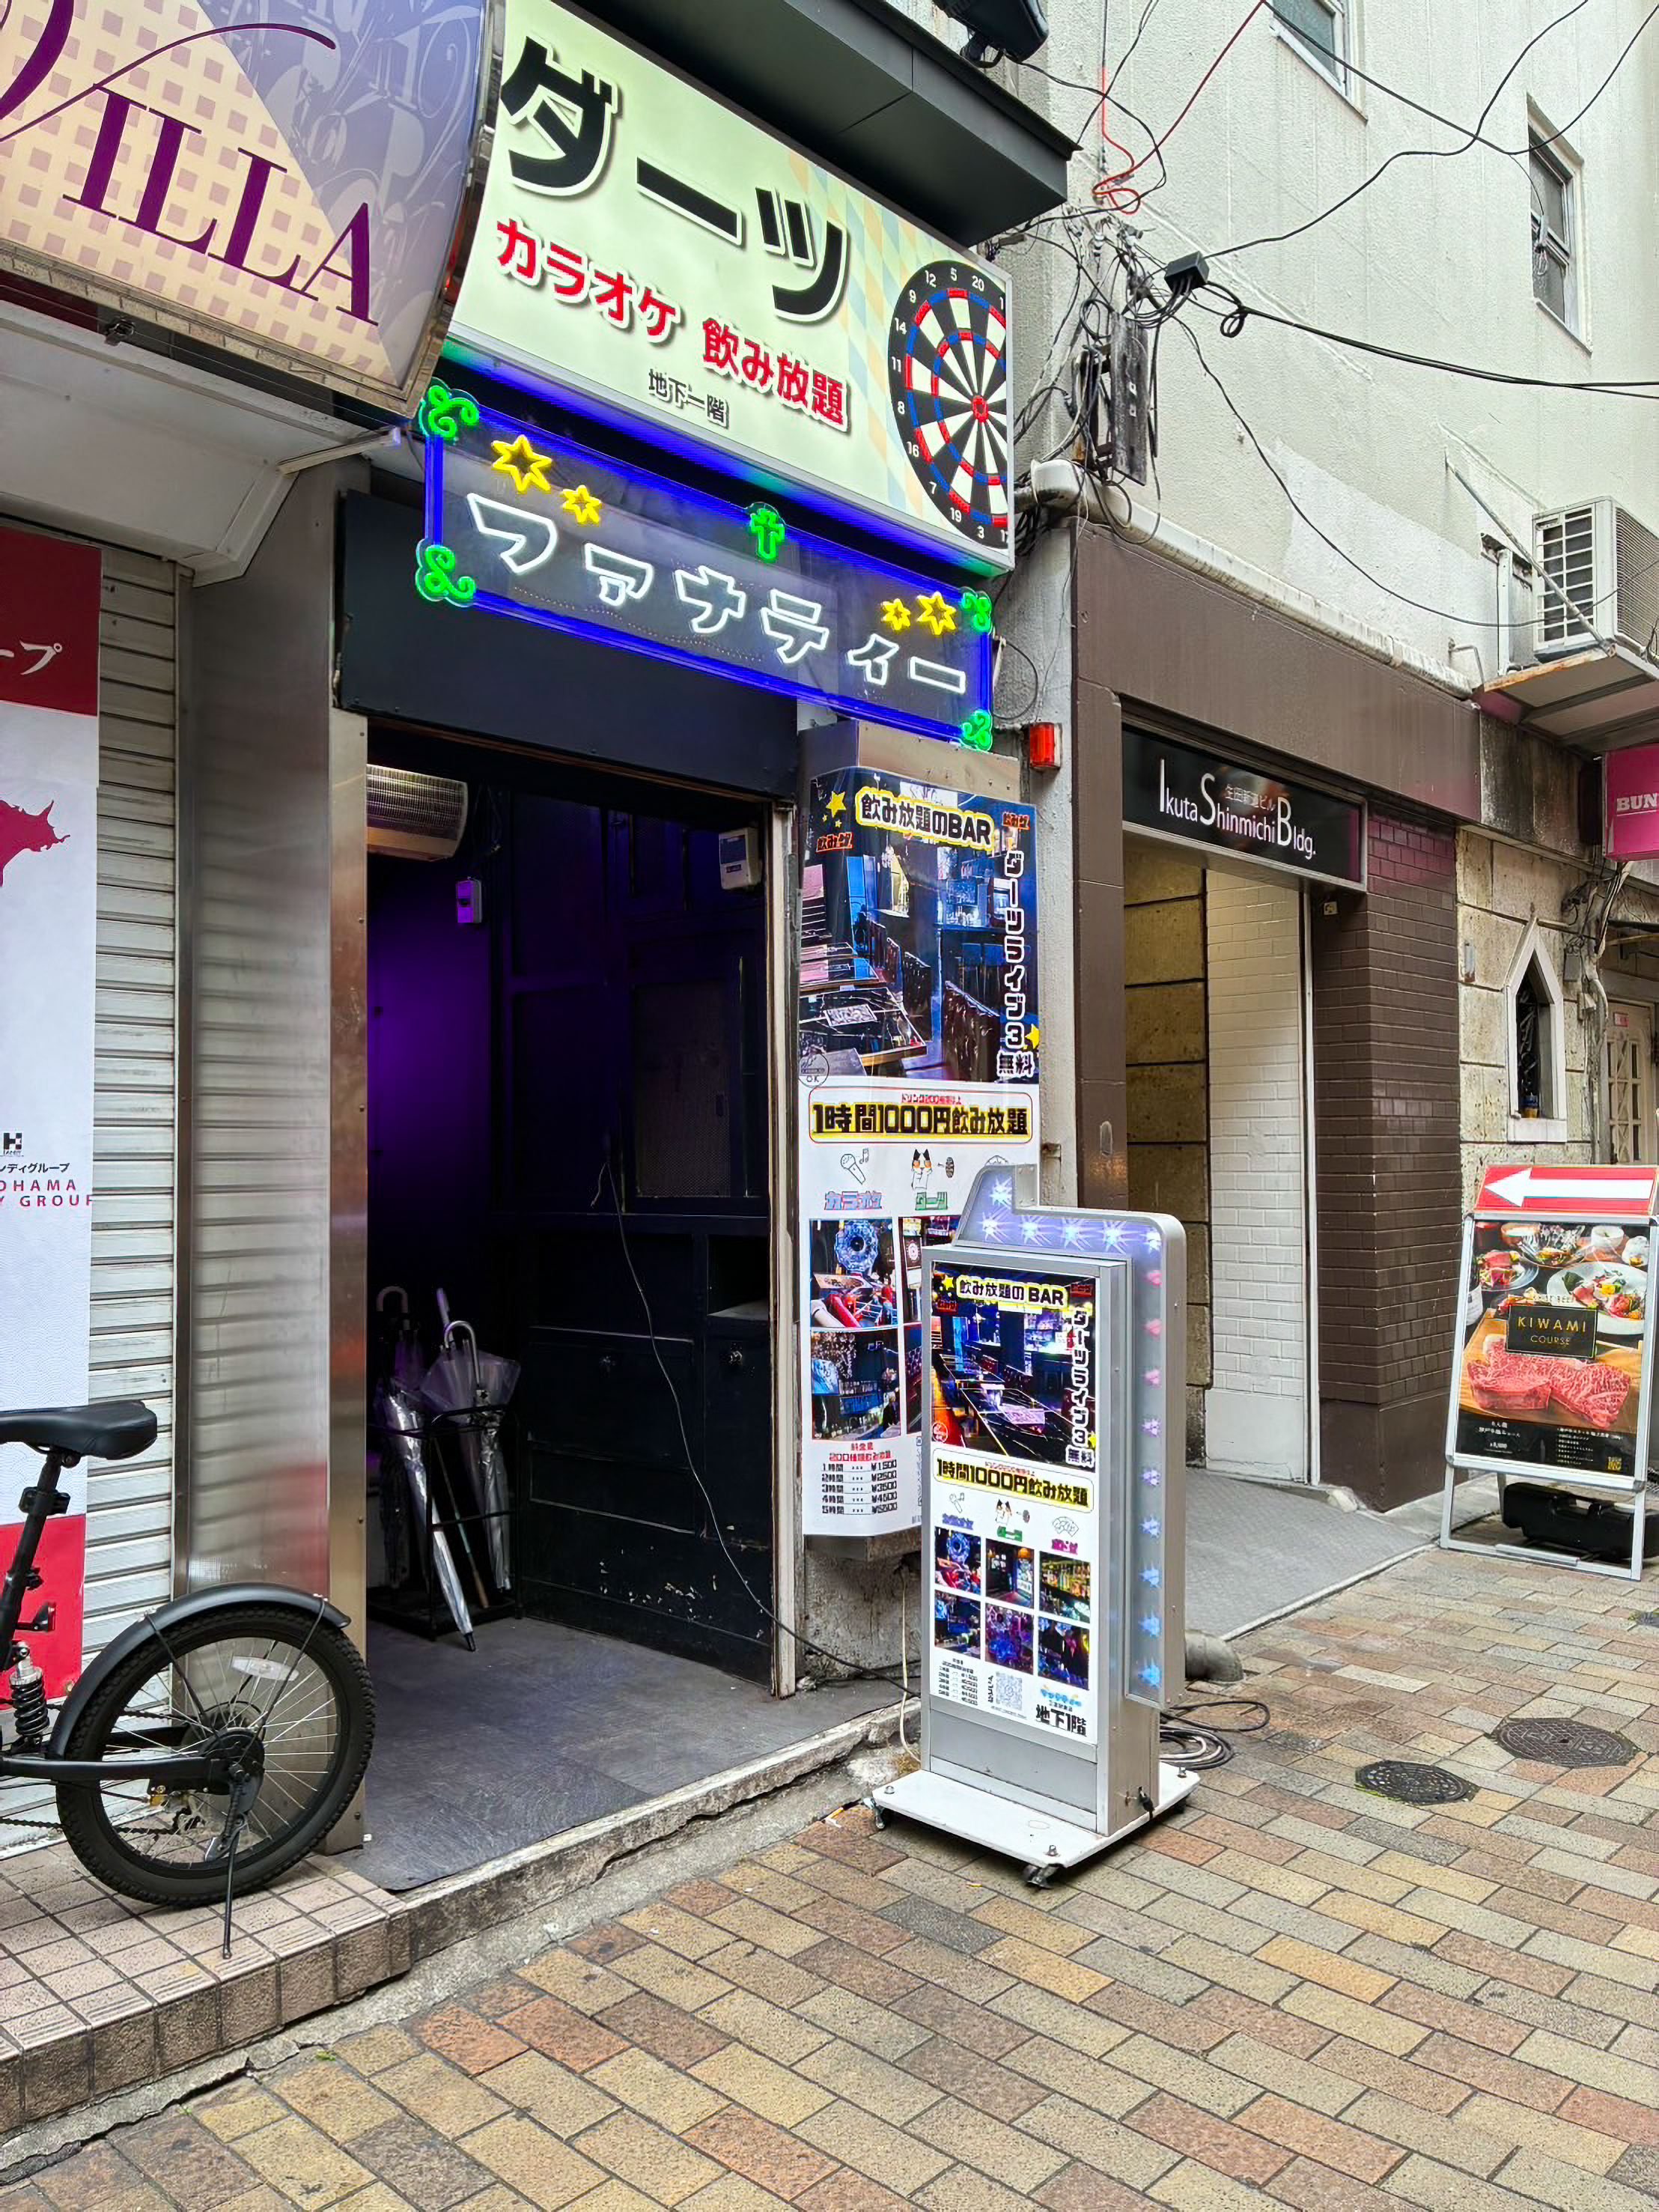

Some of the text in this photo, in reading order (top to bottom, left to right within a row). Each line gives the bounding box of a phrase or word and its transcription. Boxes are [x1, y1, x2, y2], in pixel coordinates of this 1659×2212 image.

[500, 36, 844, 317] ダーツ
[925, 270, 937, 288] 12
[951, 267, 957, 282] 5
[972, 274, 984, 292] 20
[909, 288, 916, 303] 9
[496, 218, 844, 426] カラオケ 飲み放題
[895, 317, 907, 335] 14
[892, 356, 901, 373] 11
[648, 368, 726, 426] 地下一階
[897, 401, 905, 415] 8
[907, 440, 920, 458] 16
[930, 480, 937, 495] 7
[950, 507, 962, 523] 19
[977, 526, 984, 539] 3
[1160, 758, 1317, 860] Ikuta Shinmichi Bldg.
[861, 792, 991, 845] 飲み放題のBAR
[812, 1103, 1028, 1136] 1時間1000円飲み放題
[959, 1279, 1025, 1301] 飲み放題の
[1028, 1286, 1065, 1306] BAR
[1518, 1316, 1586, 1333] KIWAMI
[1530, 1334, 1571, 1346] COURSE
[937, 1457, 1089, 1507] 1時間1000円飲み放題
[1035, 1704, 1088, 1737] 地下1階
